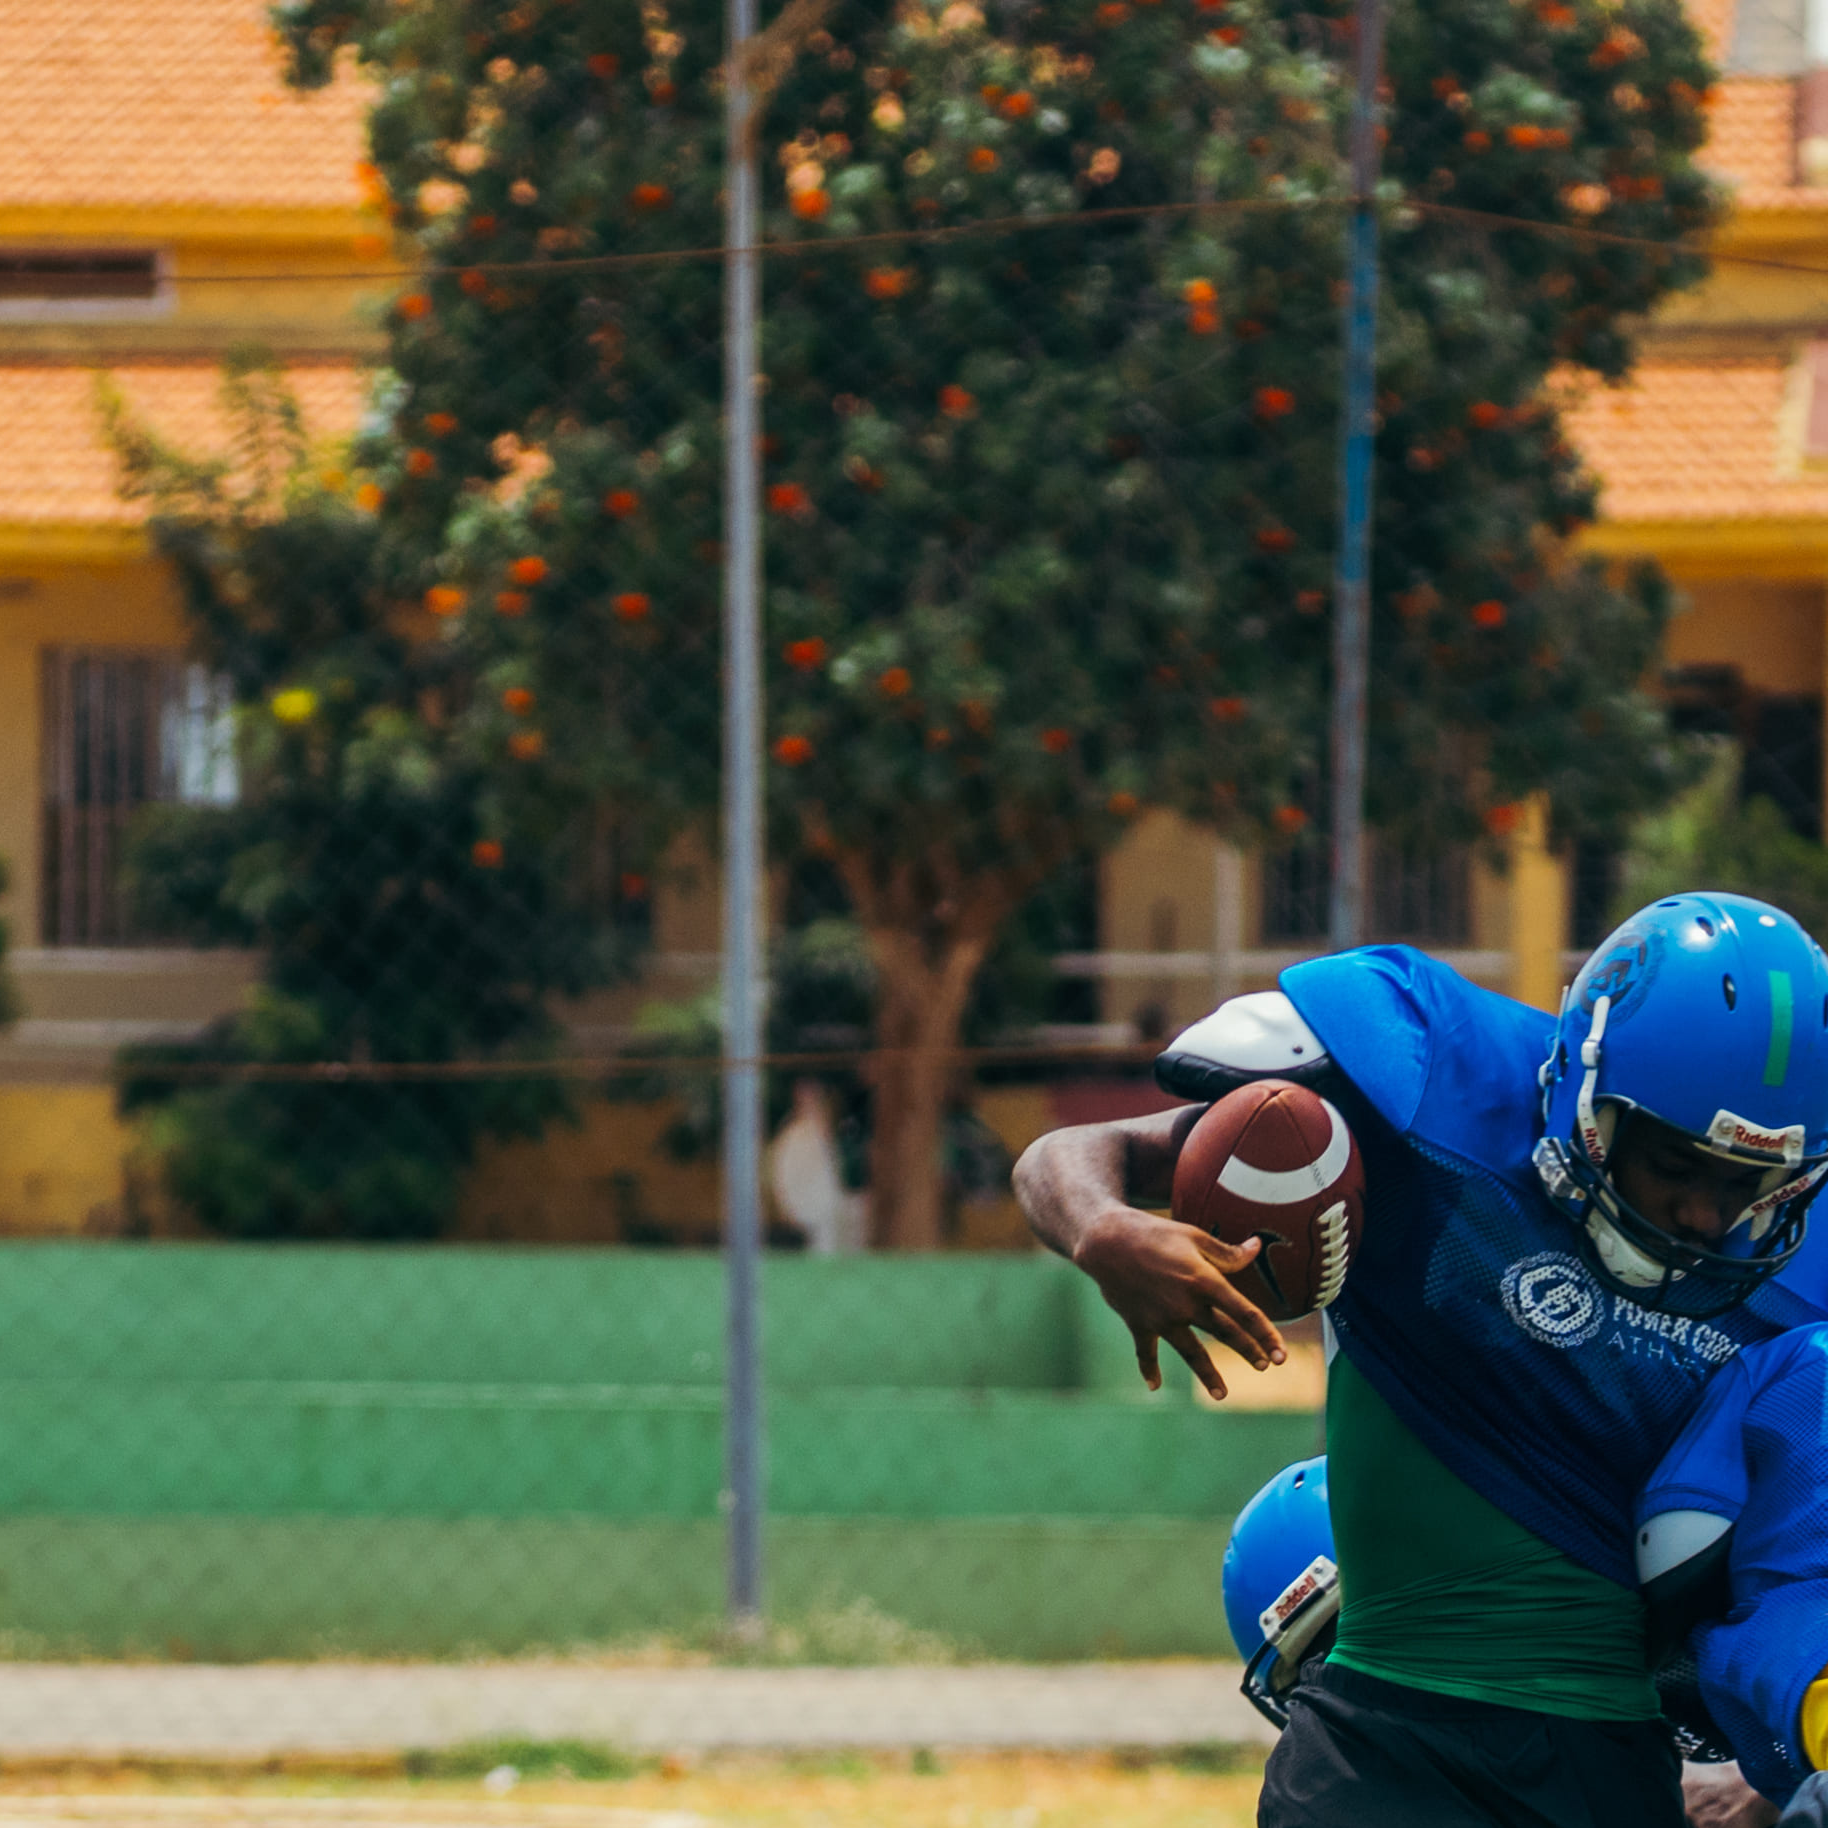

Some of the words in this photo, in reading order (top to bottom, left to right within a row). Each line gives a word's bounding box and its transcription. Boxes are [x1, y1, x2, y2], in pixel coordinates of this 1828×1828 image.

[1734, 1123, 1788, 1149] Riddell
[1750, 1176, 1811, 1215] Riddell
[1275, 1573, 1317, 1619] Riddell
